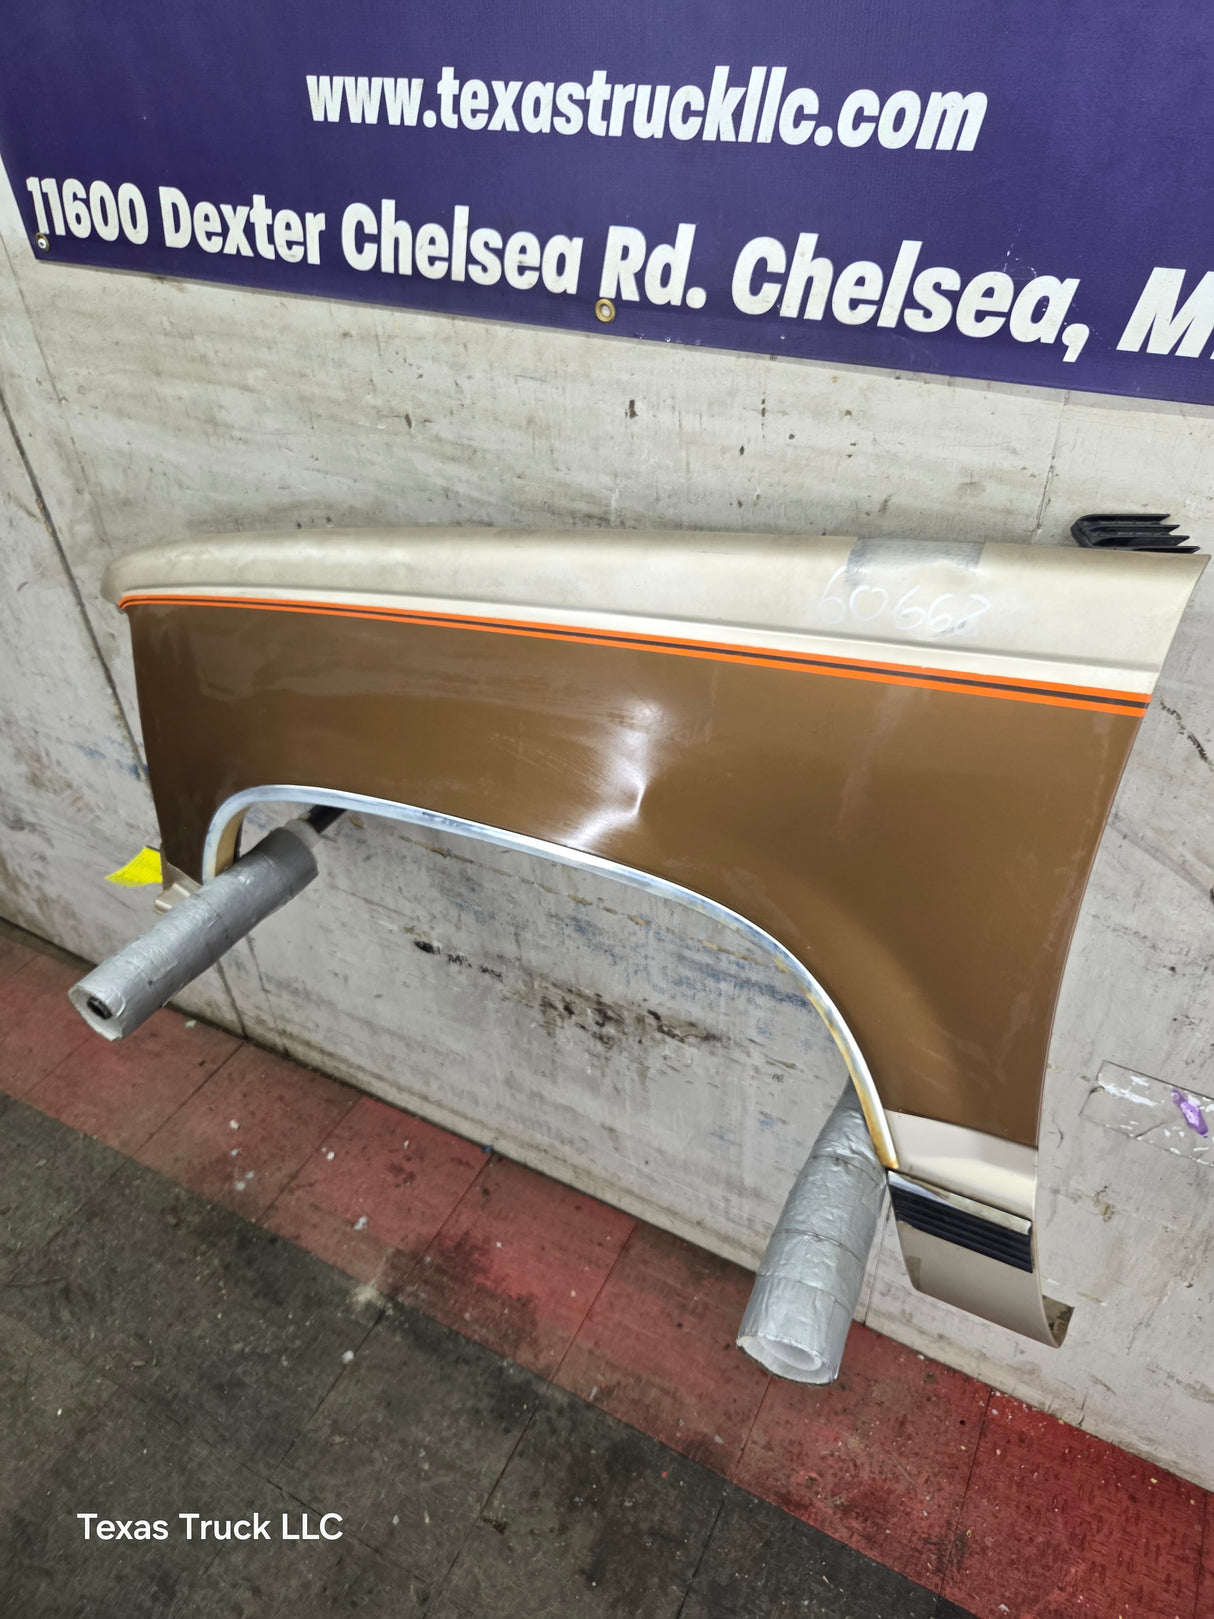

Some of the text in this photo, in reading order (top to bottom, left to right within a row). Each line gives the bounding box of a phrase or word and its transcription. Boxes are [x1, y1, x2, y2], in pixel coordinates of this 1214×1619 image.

[306, 66, 987, 152] www.texastruckllc.com
[26, 177, 1214, 363] 11600 Dexter Chelsea Rd. Chelsea, M
